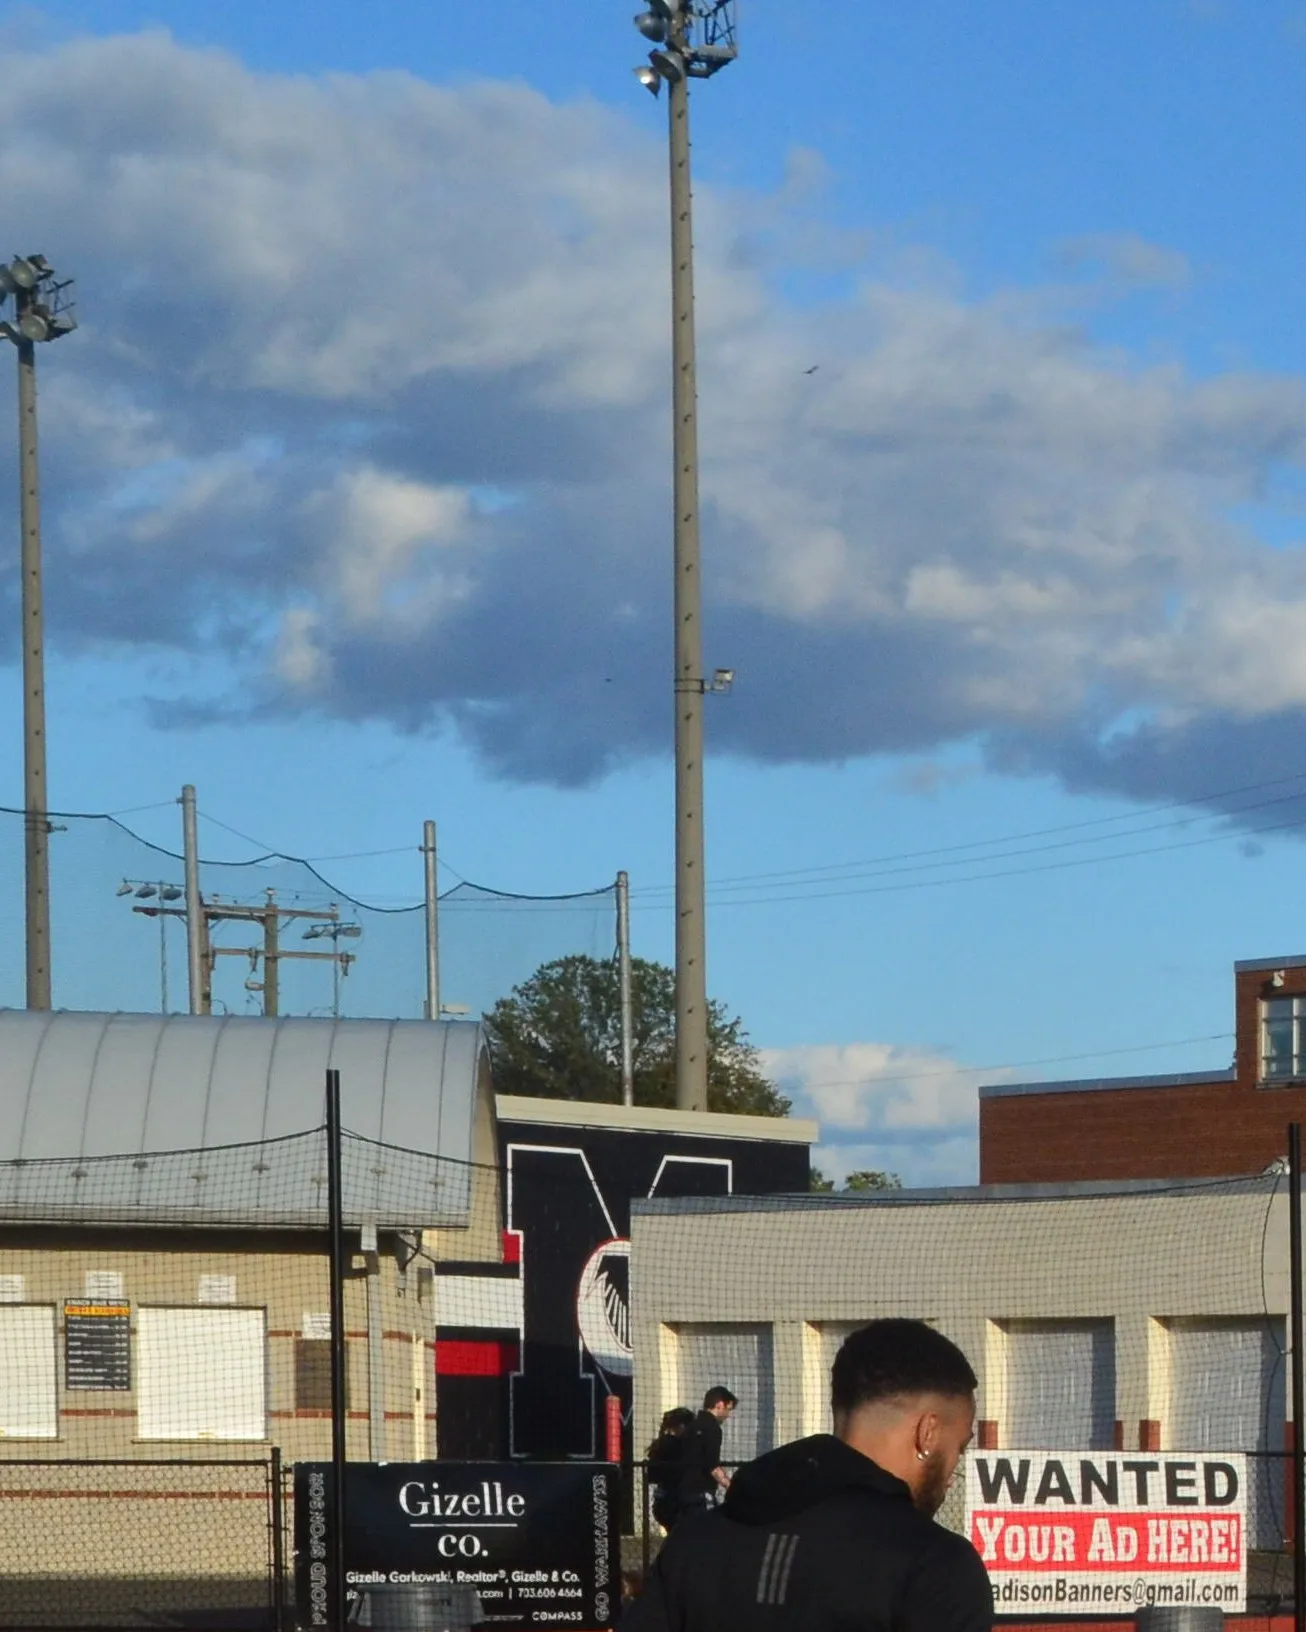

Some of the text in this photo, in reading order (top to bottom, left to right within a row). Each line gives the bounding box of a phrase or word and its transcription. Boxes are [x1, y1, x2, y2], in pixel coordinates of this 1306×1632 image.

[398, 1481, 526, 1517] Gizelle
[975, 1458, 1239, 1507] WANTED
[308, 1472, 327, 1626] PROUD SPONSOR
[592, 1474, 610, 1622] GO WARHAWKS
[976, 1516, 1238, 1563] YOUR AD HERE!
[345, 1570, 387, 1584] Gizelle
[511, 1570, 548, 1584] Gizelle
[550, 1570, 560, 1584] &
[561, 1570, 580, 1584] Co.
[990, 1578, 1239, 1605] adisonBanners@gmail.com
[532, 1611, 583, 1621] COMPASS
